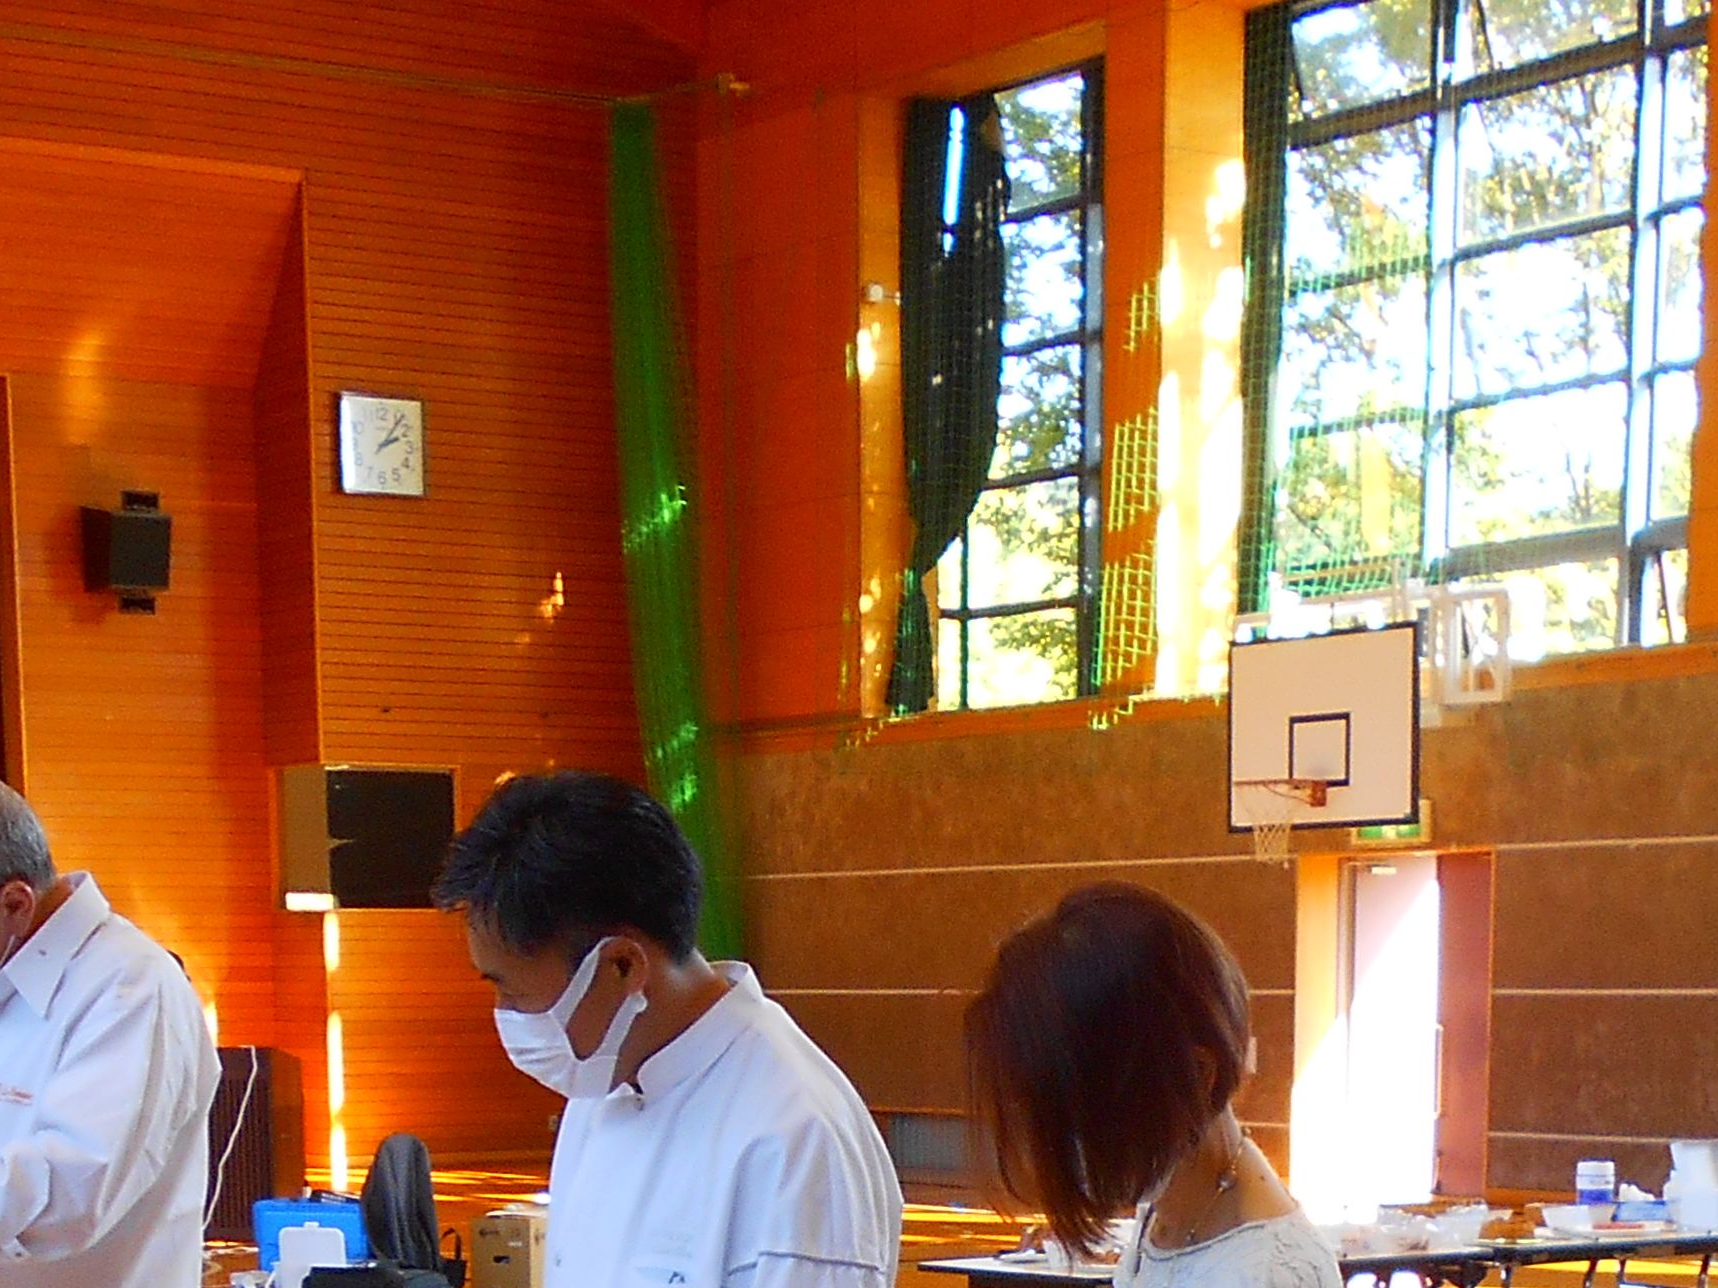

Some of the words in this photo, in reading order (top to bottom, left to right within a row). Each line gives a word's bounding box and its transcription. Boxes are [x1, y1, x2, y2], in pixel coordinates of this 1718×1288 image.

[375, 407, 388, 421] 12
[400, 423, 411, 437] 2
[405, 440, 414, 454] 3
[401, 457, 410, 469] 4
[378, 471, 386, 485] 6
[392, 467, 401, 481] 5
